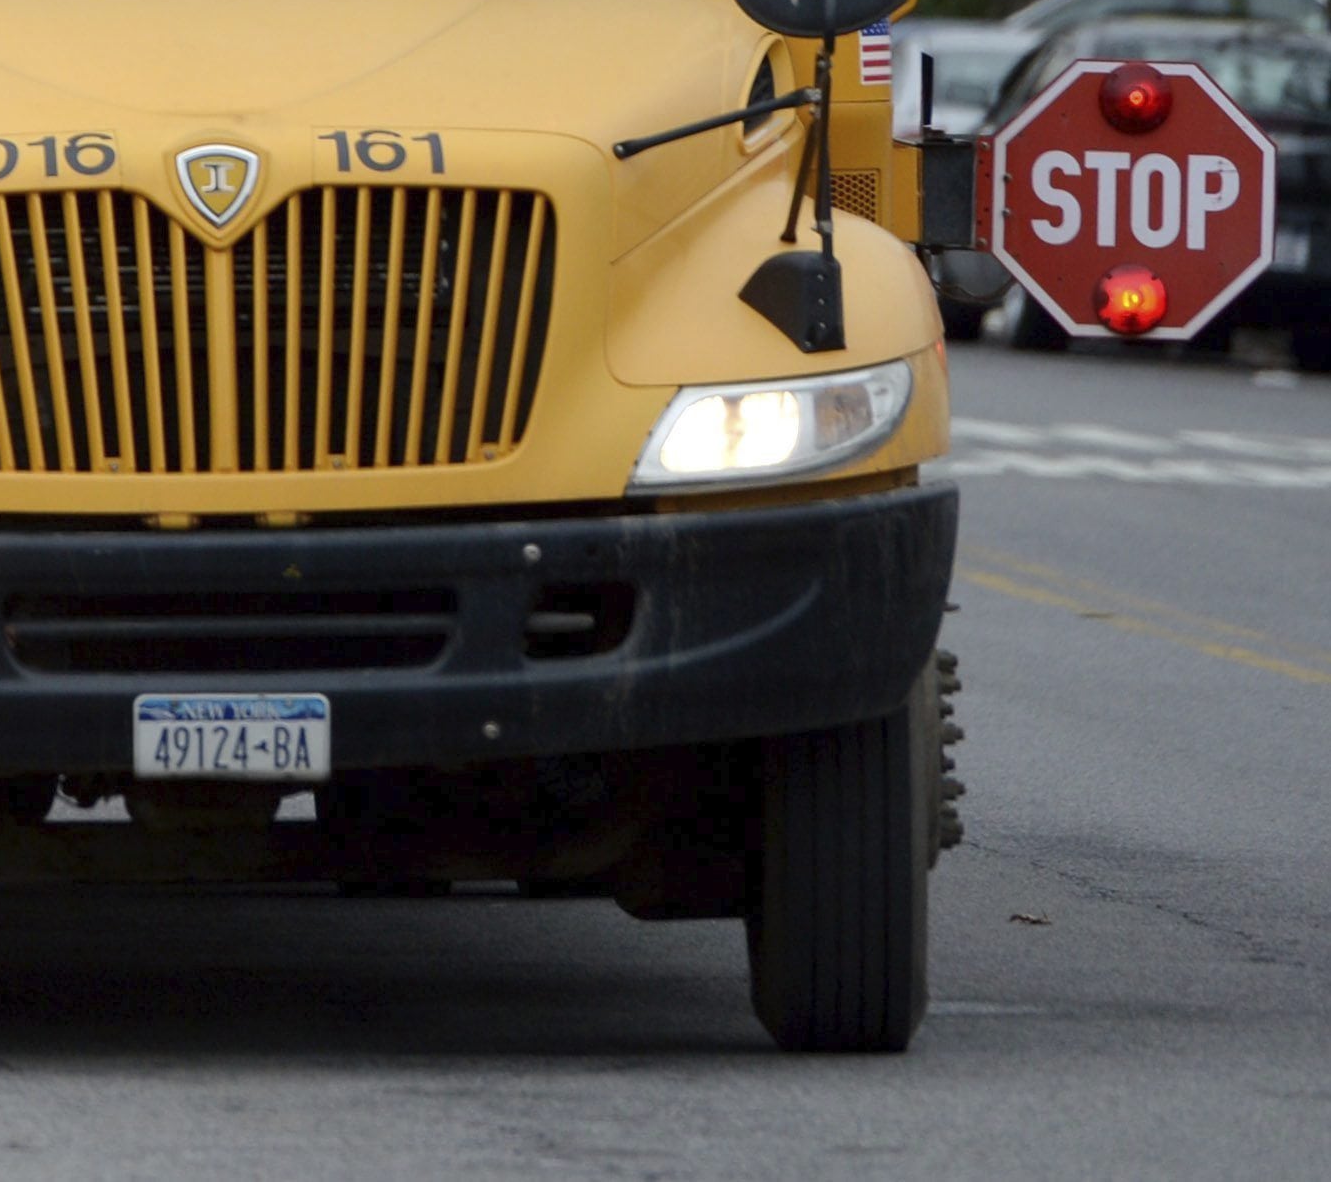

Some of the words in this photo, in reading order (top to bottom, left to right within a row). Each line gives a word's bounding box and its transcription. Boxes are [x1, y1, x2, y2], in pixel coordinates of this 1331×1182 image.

[318, 129, 445, 175] 161
[1031, 150, 1240, 250] STOP
[184, 701, 224, 720] NEW
